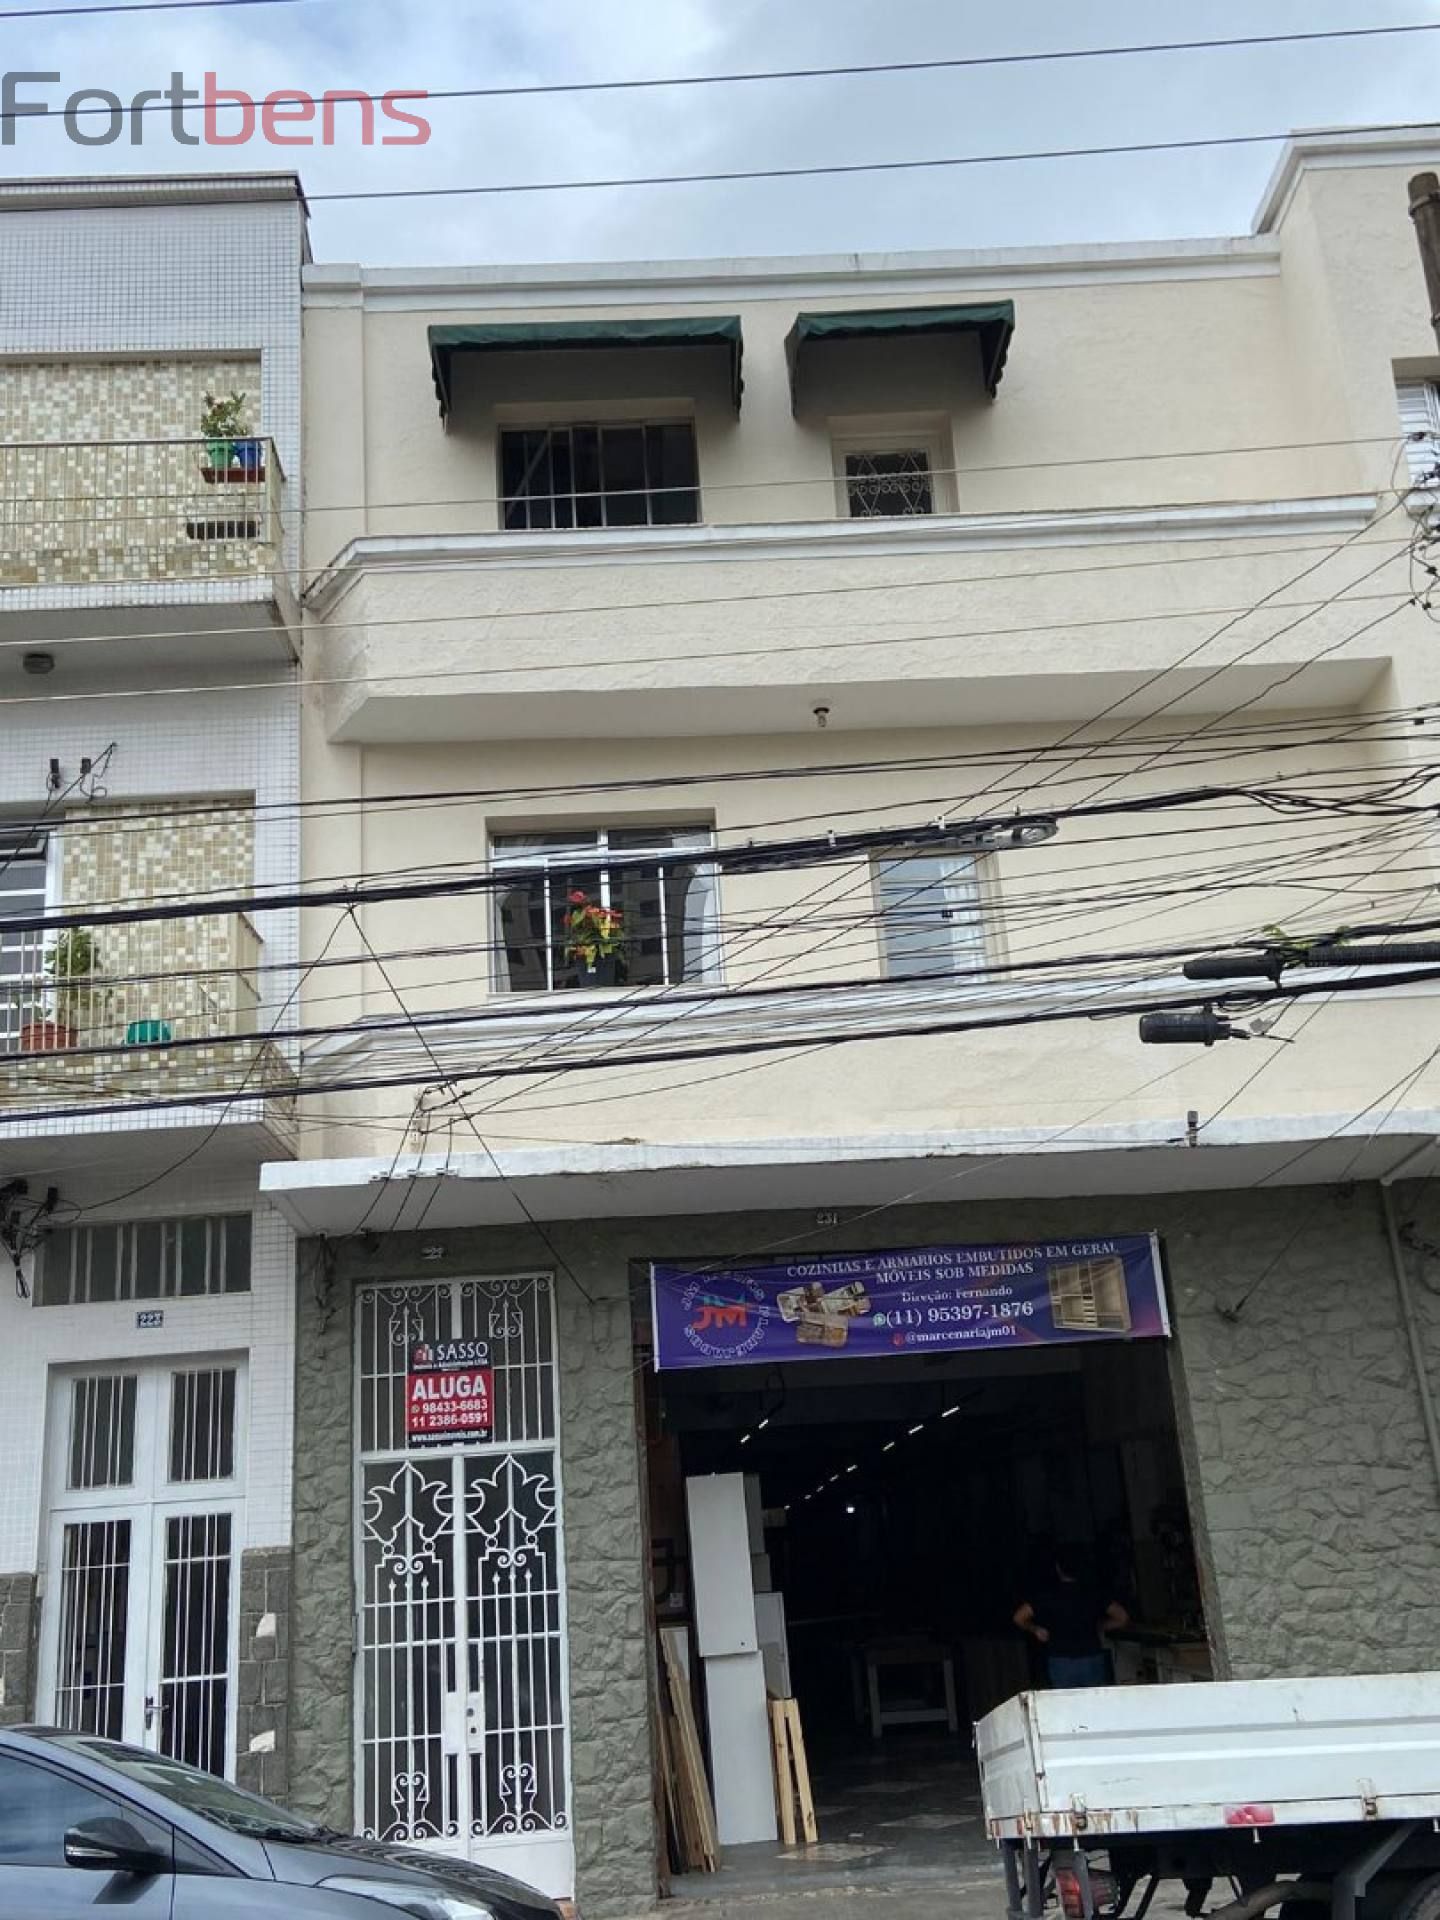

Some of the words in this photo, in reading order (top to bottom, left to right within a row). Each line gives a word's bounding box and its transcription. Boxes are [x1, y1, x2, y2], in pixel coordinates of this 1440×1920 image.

[787, 1260, 861, 1277] COZINHAS
[865, 1260, 875, 1271] E
[878, 1253, 952, 1270] ARMARIOS
[957, 1247, 1043, 1264] EMBUTIDOS
[1046, 1245, 1068, 1258] EM
[1072, 1242, 1119, 1256] GERAL
[876, 1268, 931, 1284] MÓVEIS
[935, 1267, 964, 1280] SOB
[968, 1262, 1034, 1278] MEDIDAS
[955, 1286, 1013, 1299] Fernando
[692, 1306, 748, 1330] JM
[886, 1308, 922, 1329] (11)
[928, 1300, 1034, 1323] 95397-1876
[436, 1341, 489, 1361] SASSO
[412, 1375, 487, 1400] ALUGA
[412, 1416, 426, 1427] 11
